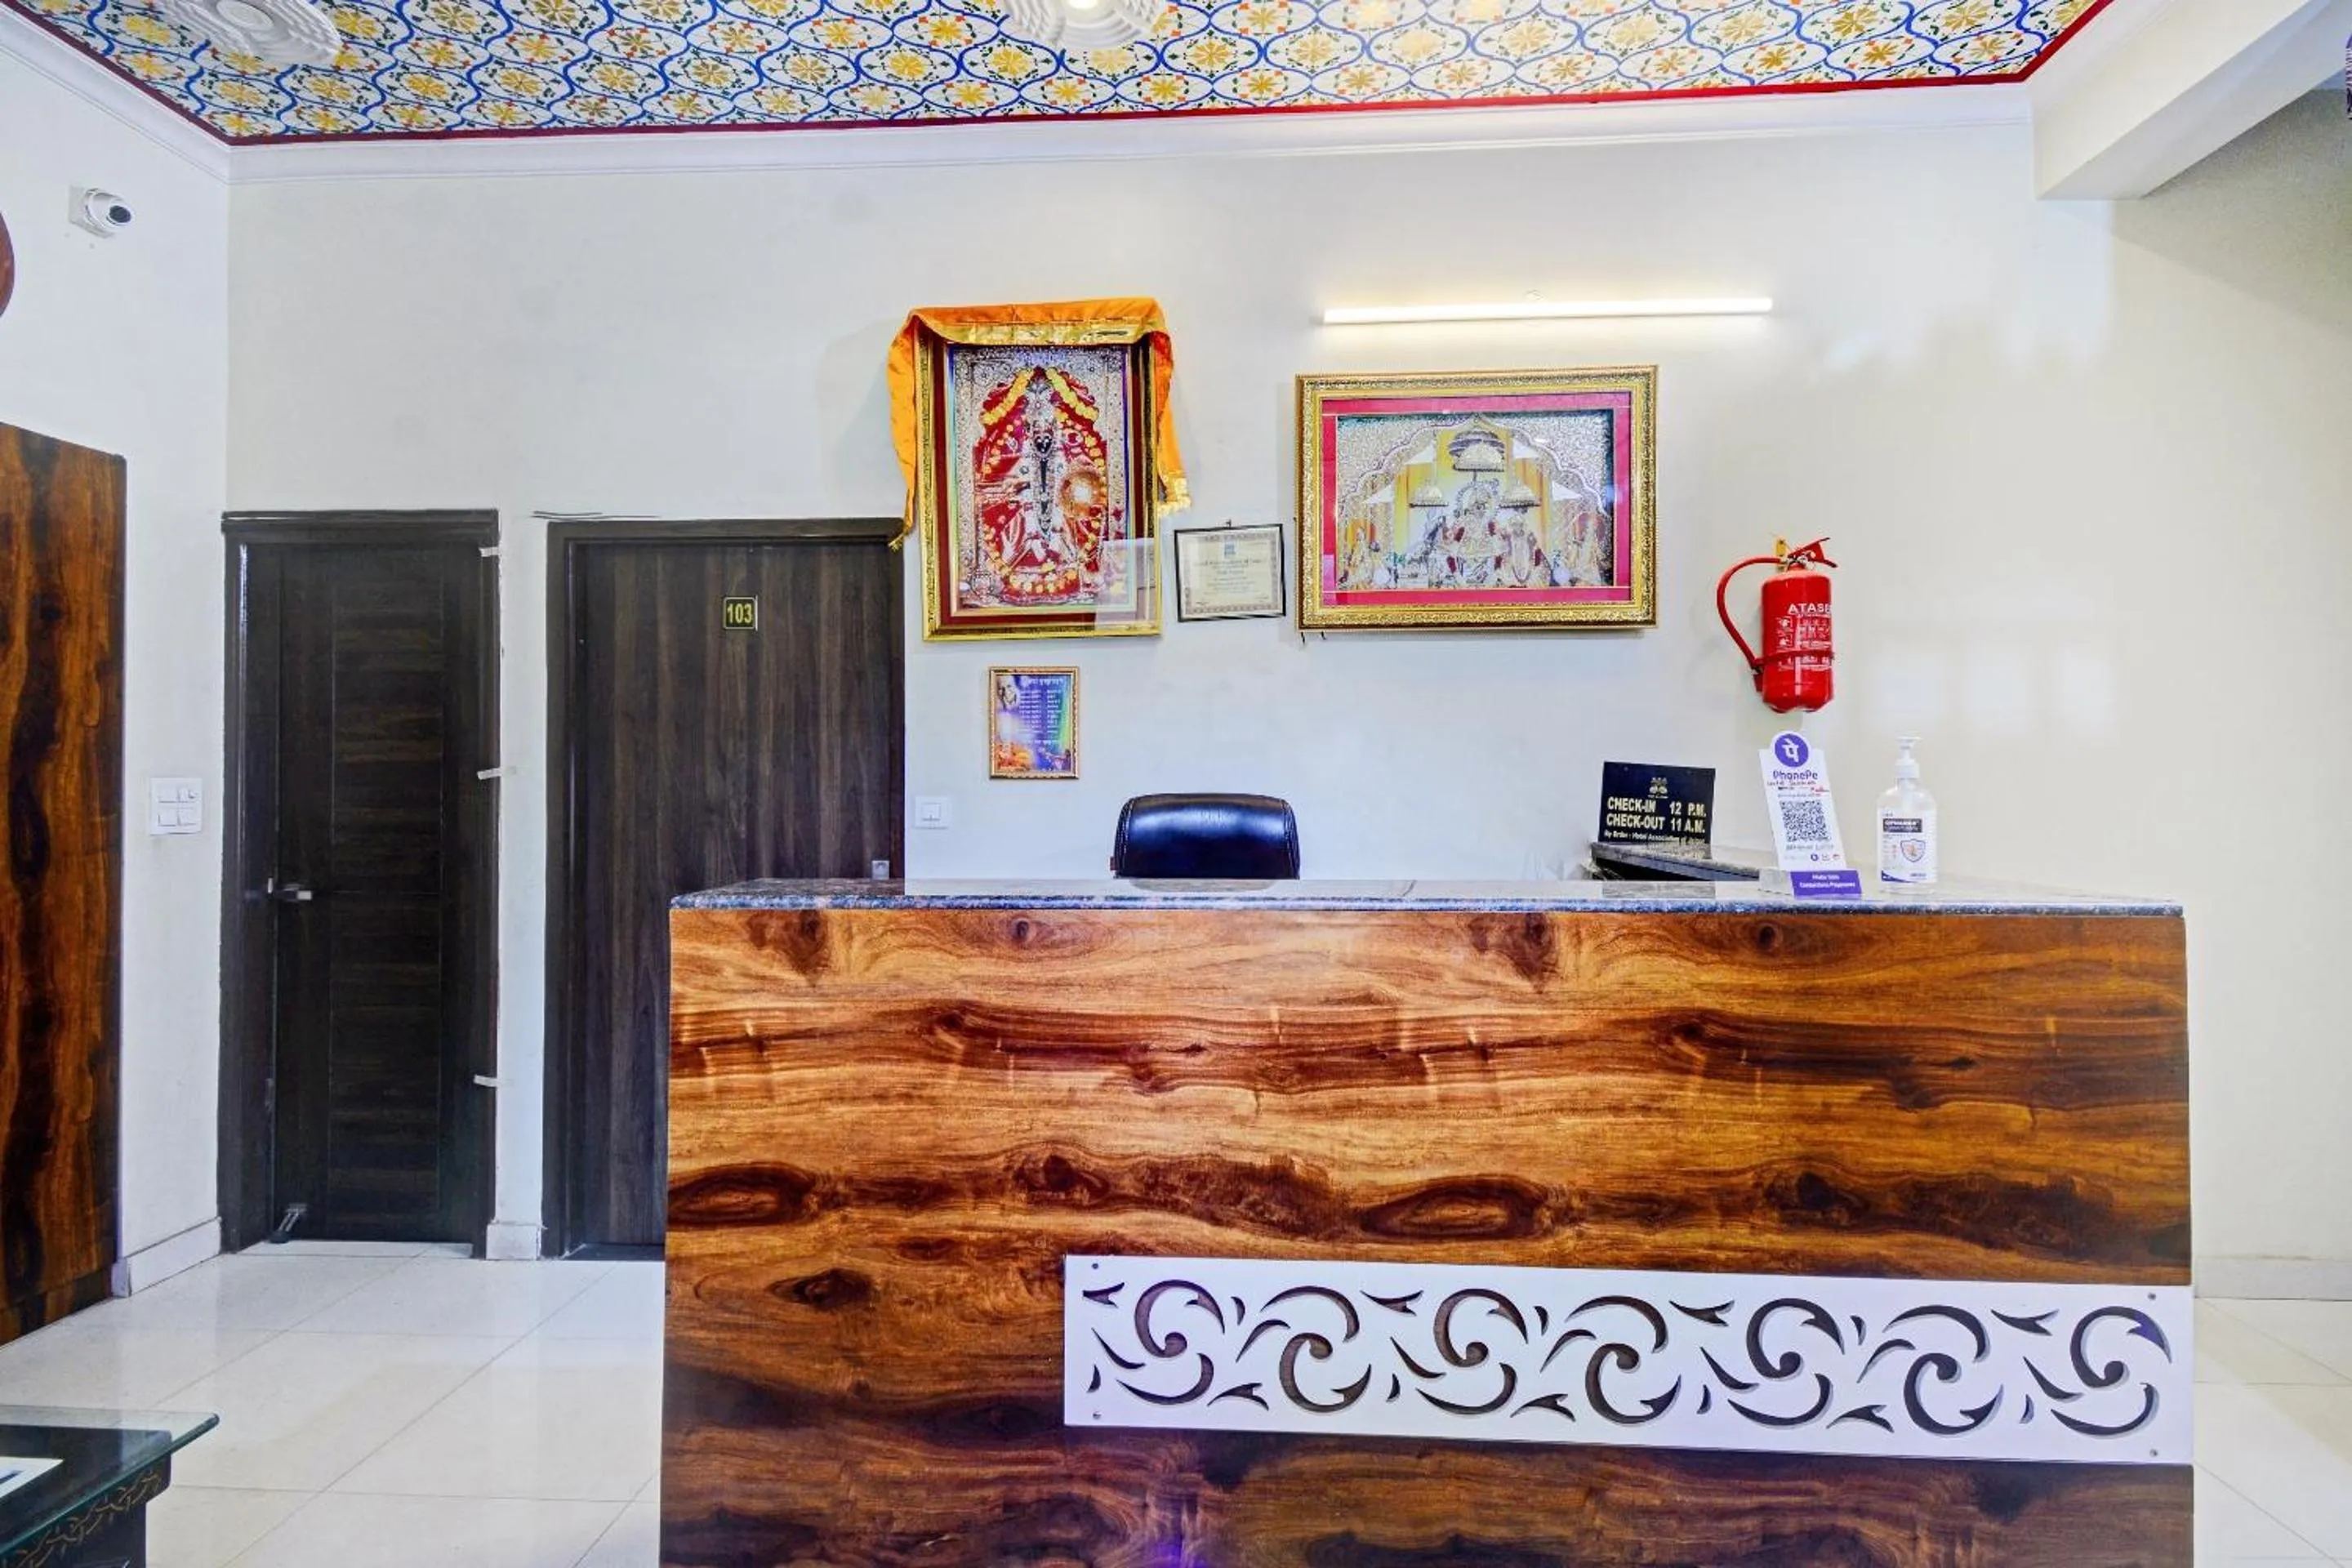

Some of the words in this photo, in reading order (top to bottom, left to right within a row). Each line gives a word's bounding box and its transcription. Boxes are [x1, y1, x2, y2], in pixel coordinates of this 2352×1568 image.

[727, 603, 752, 624] 103
[1772, 769, 1819, 781] PhonePe
[1607, 796, 1656, 813] CHECK-IN
[1669, 801, 1682, 815] 12
[1606, 813, 1665, 830] CHECK-OUT
[1670, 817, 1682, 831] 11
